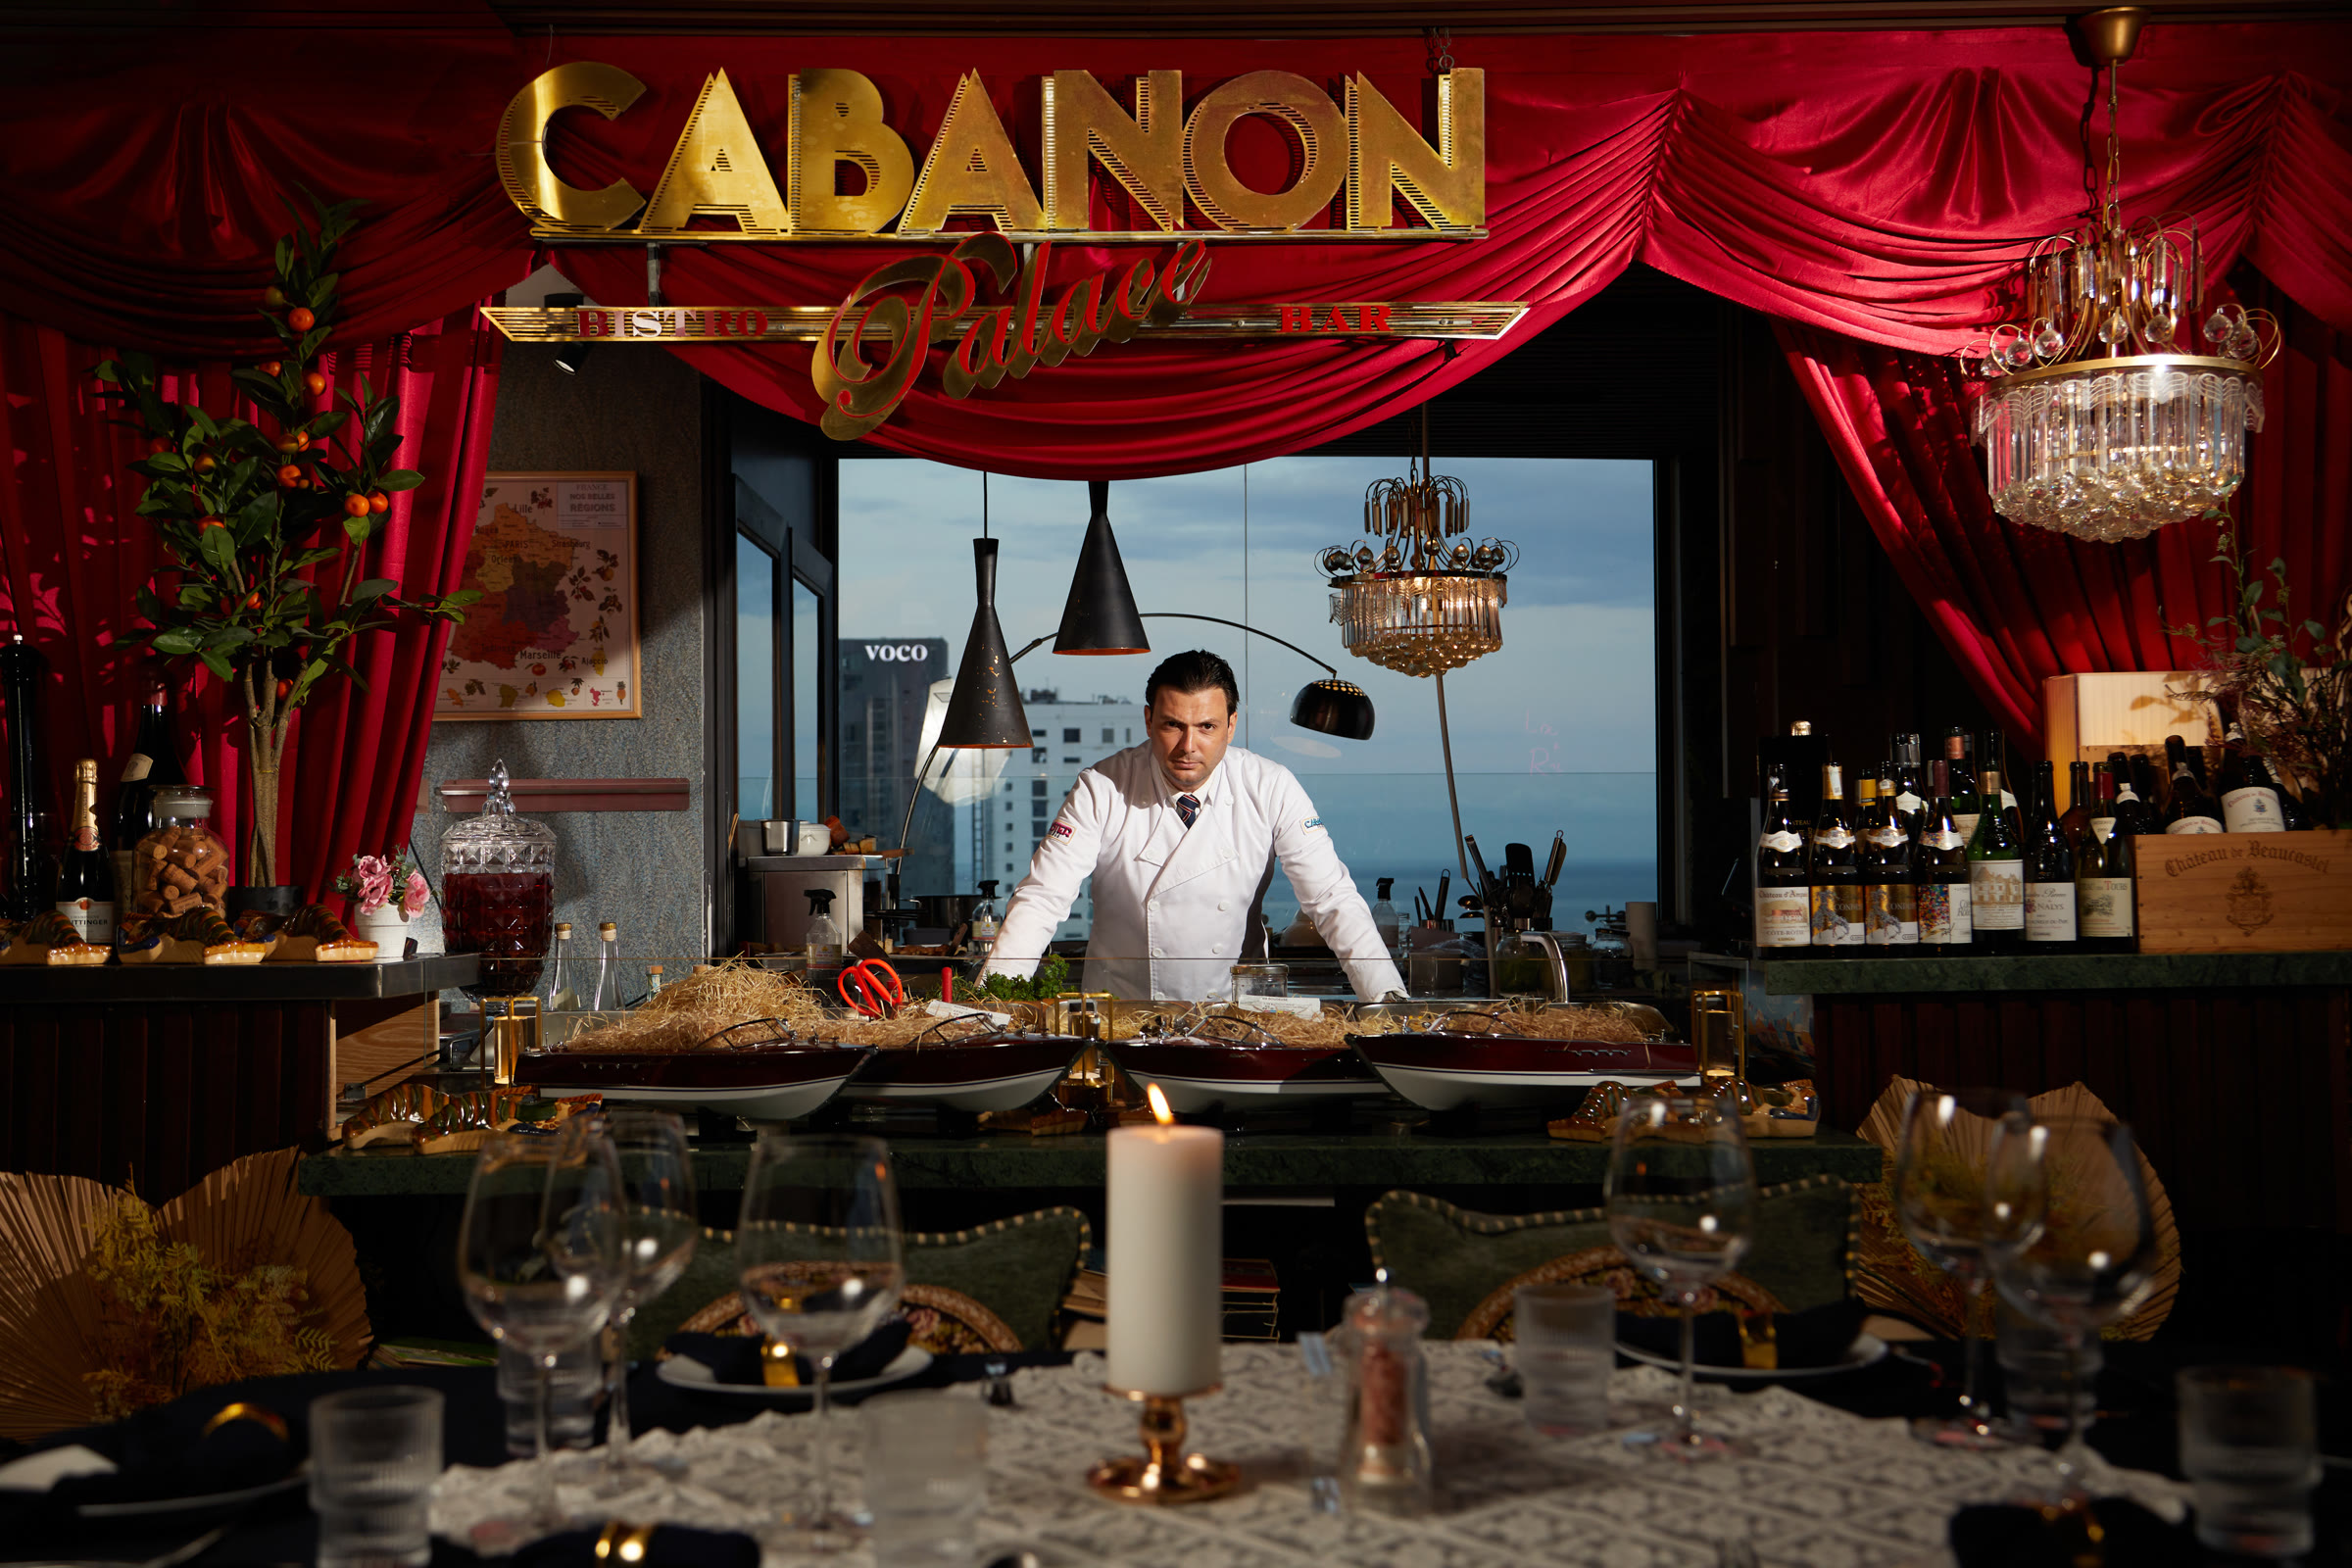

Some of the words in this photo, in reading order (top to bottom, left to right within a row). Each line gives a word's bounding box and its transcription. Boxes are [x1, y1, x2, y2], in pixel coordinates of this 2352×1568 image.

[496, 61, 1486, 233] CABANON
[577, 309, 769, 339] BISTRO
[1279, 305, 1394, 333] BAR
[812, 231, 1211, 440] Palace
[514, 504, 533, 514] Lille
[505, 539, 529, 549] PARIS
[519, 649, 563, 661] Marseille
[581, 657, 609, 666] Ajaccio
[2165, 847, 2230, 877] Château
[2230, 846, 2243, 858] de
[2247, 839, 2330, 874] Beaucastel
